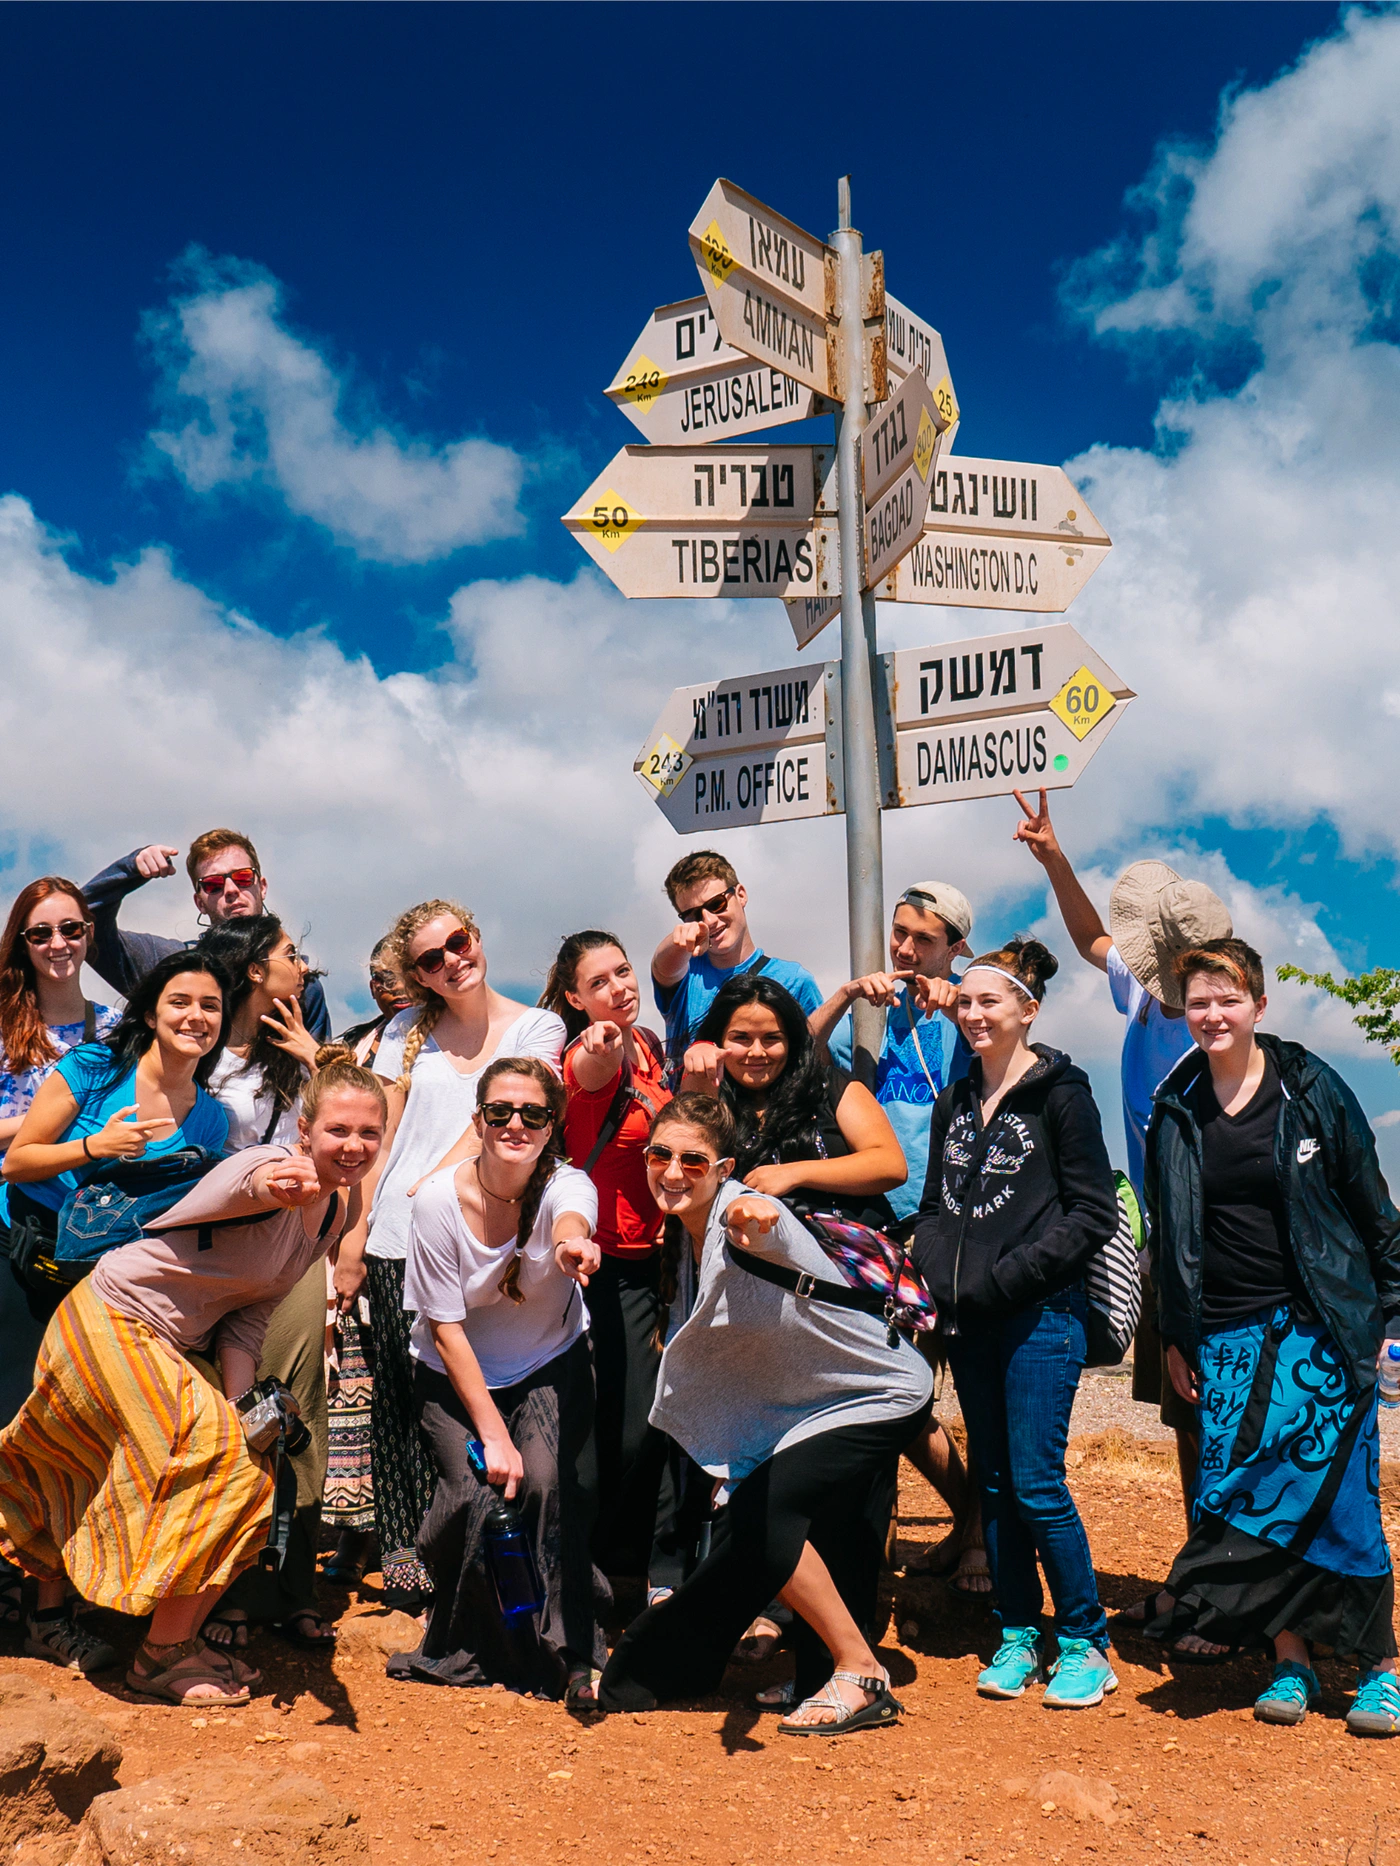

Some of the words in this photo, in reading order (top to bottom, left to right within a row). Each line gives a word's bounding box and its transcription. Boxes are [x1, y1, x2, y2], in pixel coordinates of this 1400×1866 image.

[711, 262, 723, 279] Km
[749, 216, 805, 292] עמאן
[743, 289, 815, 373] AMMAN
[624, 371, 660, 393] 240
[637, 394, 651, 402] Km
[681, 368, 799, 434] JERUSALEM
[938, 389, 952, 417] 25
[872, 398, 907, 475] בגדד
[917, 424, 932, 459] 800
[694, 464, 794, 508] טבריה
[592, 507, 629, 528] 50
[602, 529, 620, 539] Km
[871, 478, 913, 564] BAGDAD
[672, 539, 813, 583] TIBERIAS
[911, 544, 1010, 593] WASHINGTON
[920, 643, 1044, 715] דמשק
[1066, 685, 1099, 714] 60
[749, 680, 808, 731] משרד
[1073, 716, 1090, 725] Km
[650, 751, 683, 775] 243
[917, 725, 1047, 787] DAMASCUS
[695, 770, 731, 815] P.M.
[737, 757, 809, 809] OFFICE
[972, 1184, 1015, 1219] MARK
